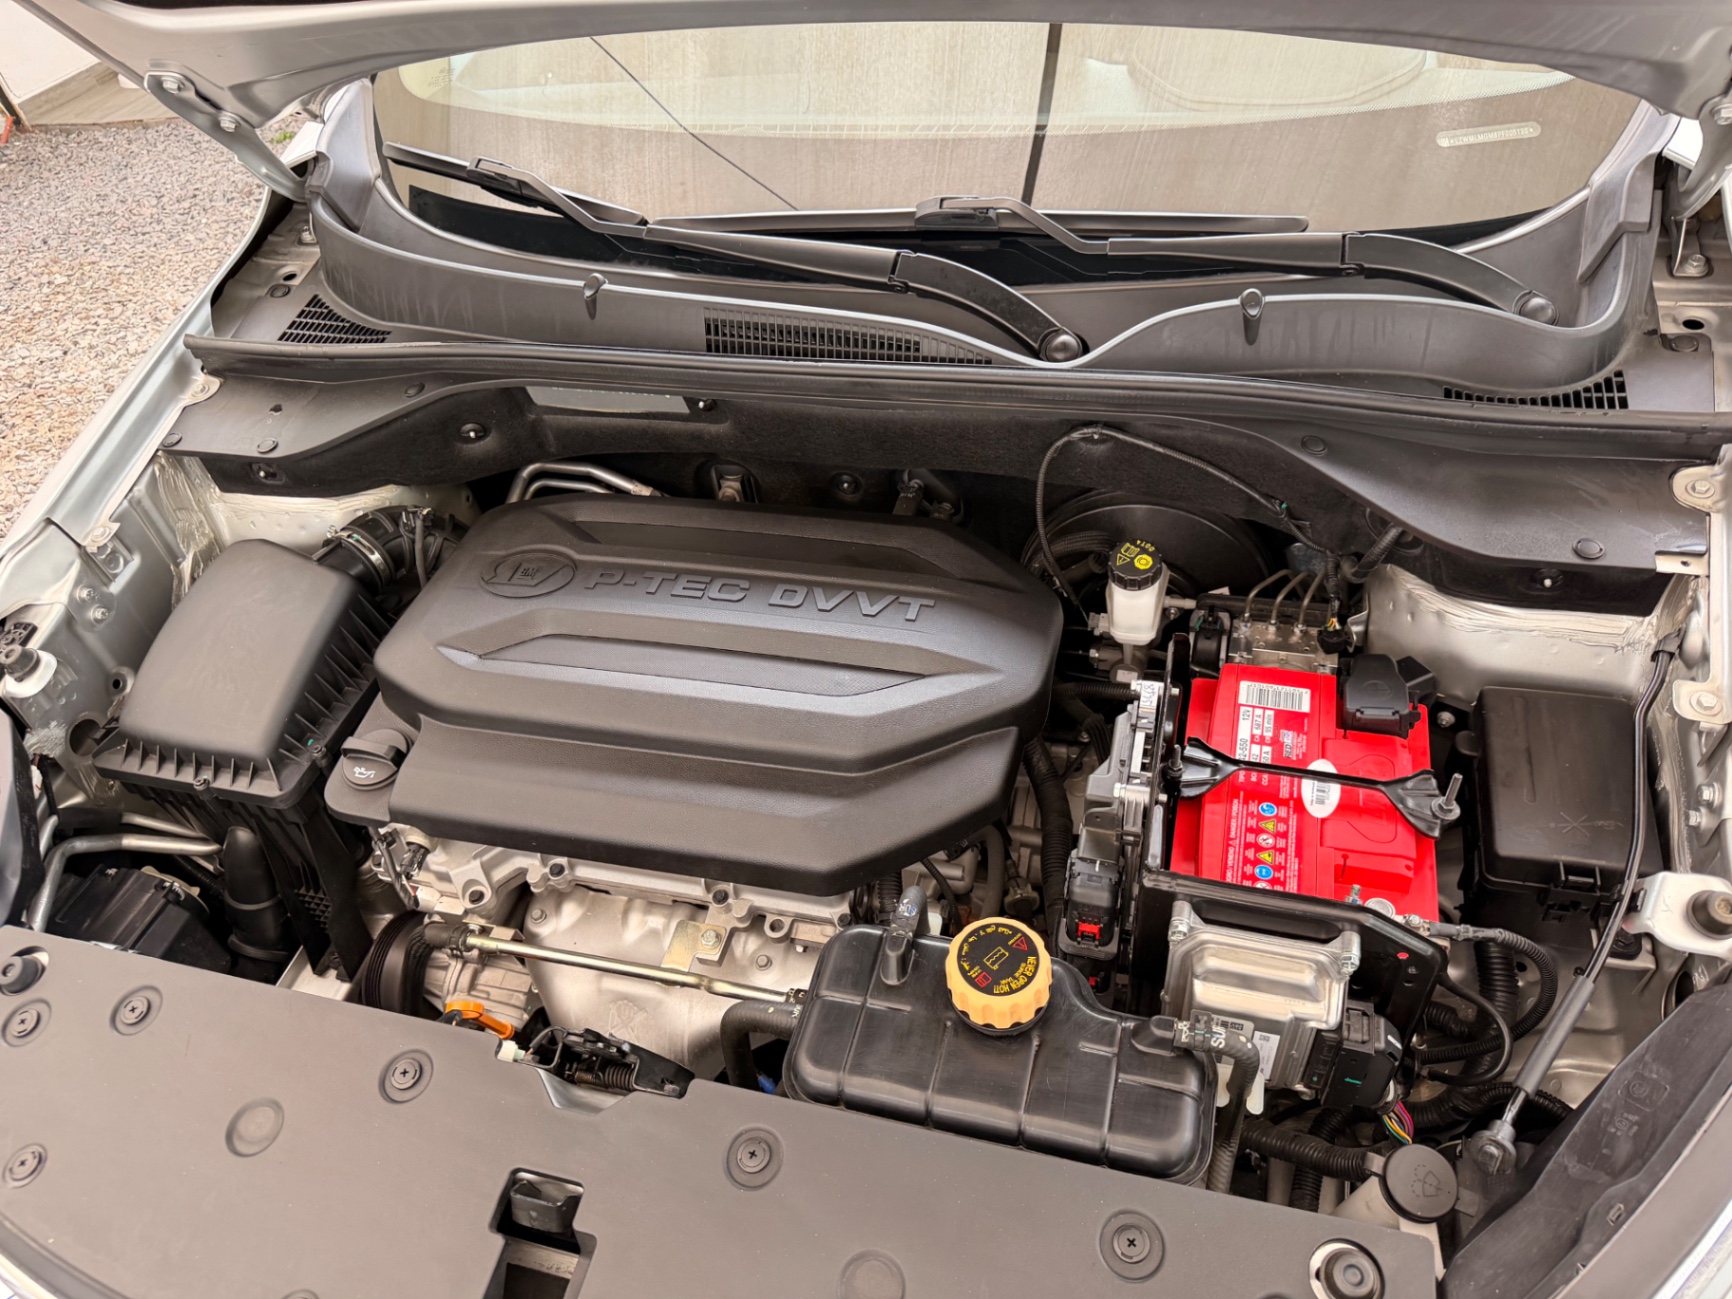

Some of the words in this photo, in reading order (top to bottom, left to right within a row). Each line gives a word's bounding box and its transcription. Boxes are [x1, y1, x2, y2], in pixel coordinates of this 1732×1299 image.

[583, 568, 751, 602] P-TEC
[767, 586, 937, 622] DVVT
[1241, 708, 1251, 721] 12V
[1024, 956, 1037, 977] NEVER
[1010, 975, 1028, 990] OPEN
